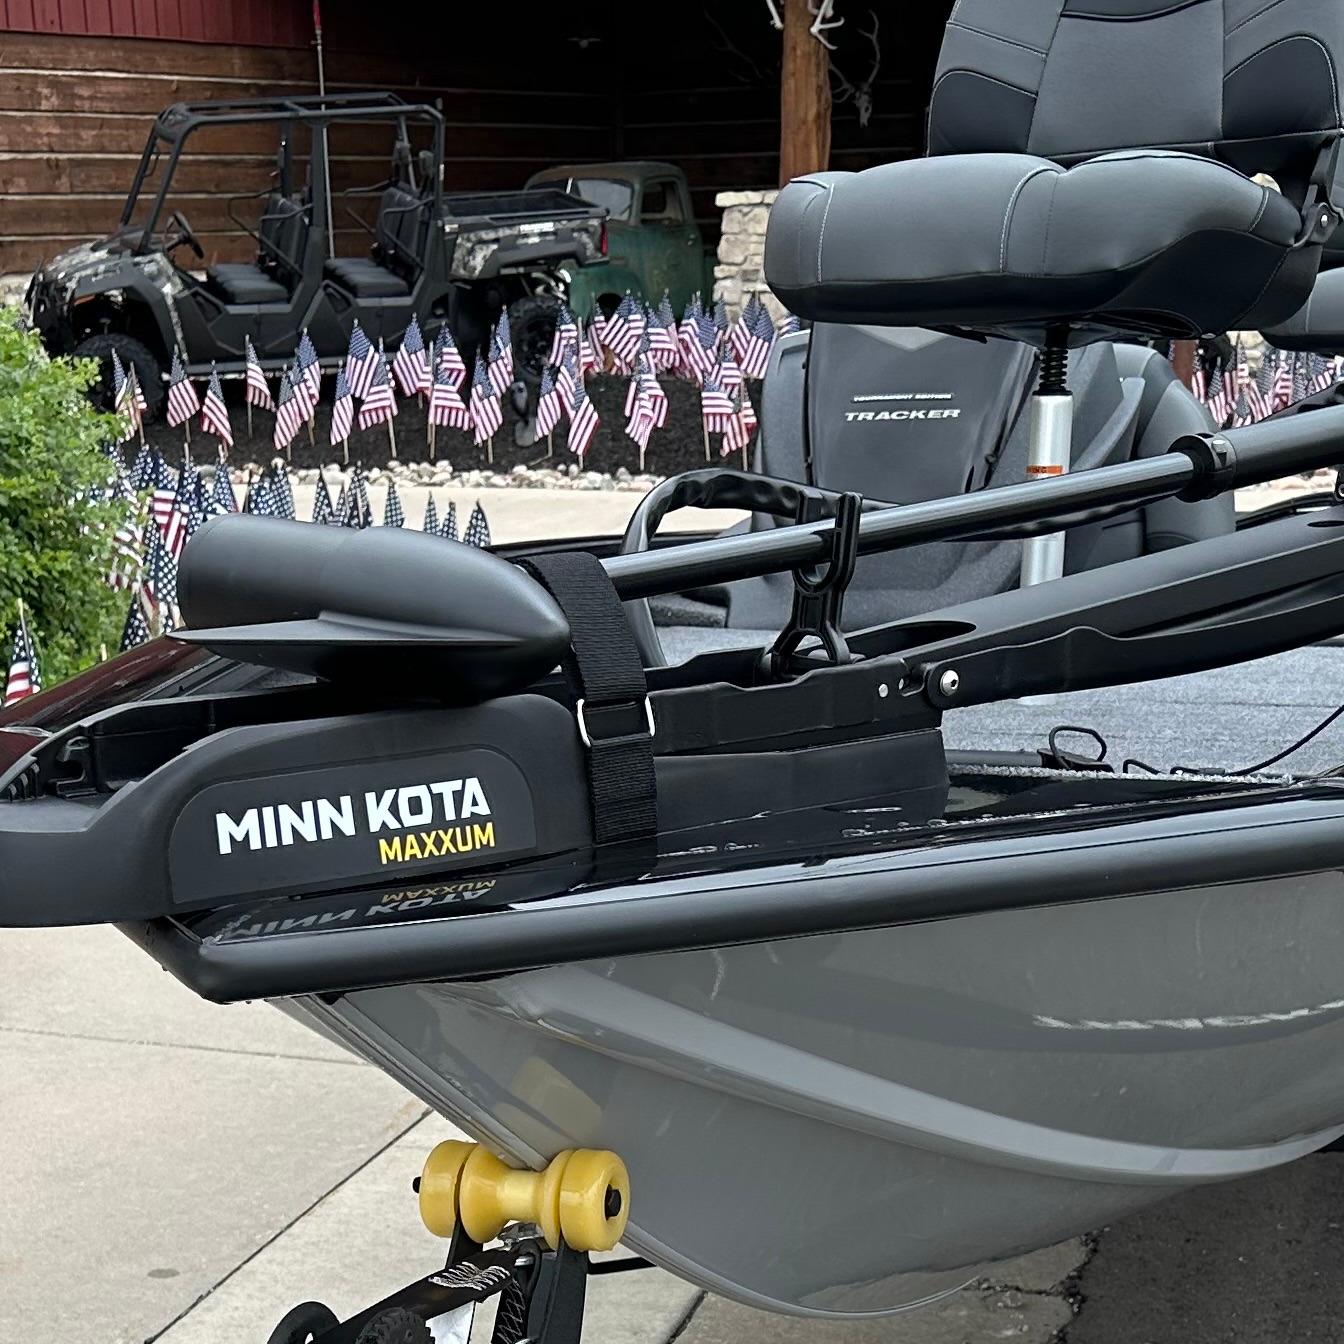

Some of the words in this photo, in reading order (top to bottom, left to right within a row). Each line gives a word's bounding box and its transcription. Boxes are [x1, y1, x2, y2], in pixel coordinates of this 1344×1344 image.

[844, 408, 962, 422] TRACKER
[215, 795, 357, 855] MINN
[364, 776, 493, 833] KOTA
[378, 821, 496, 865] MAXXUM
